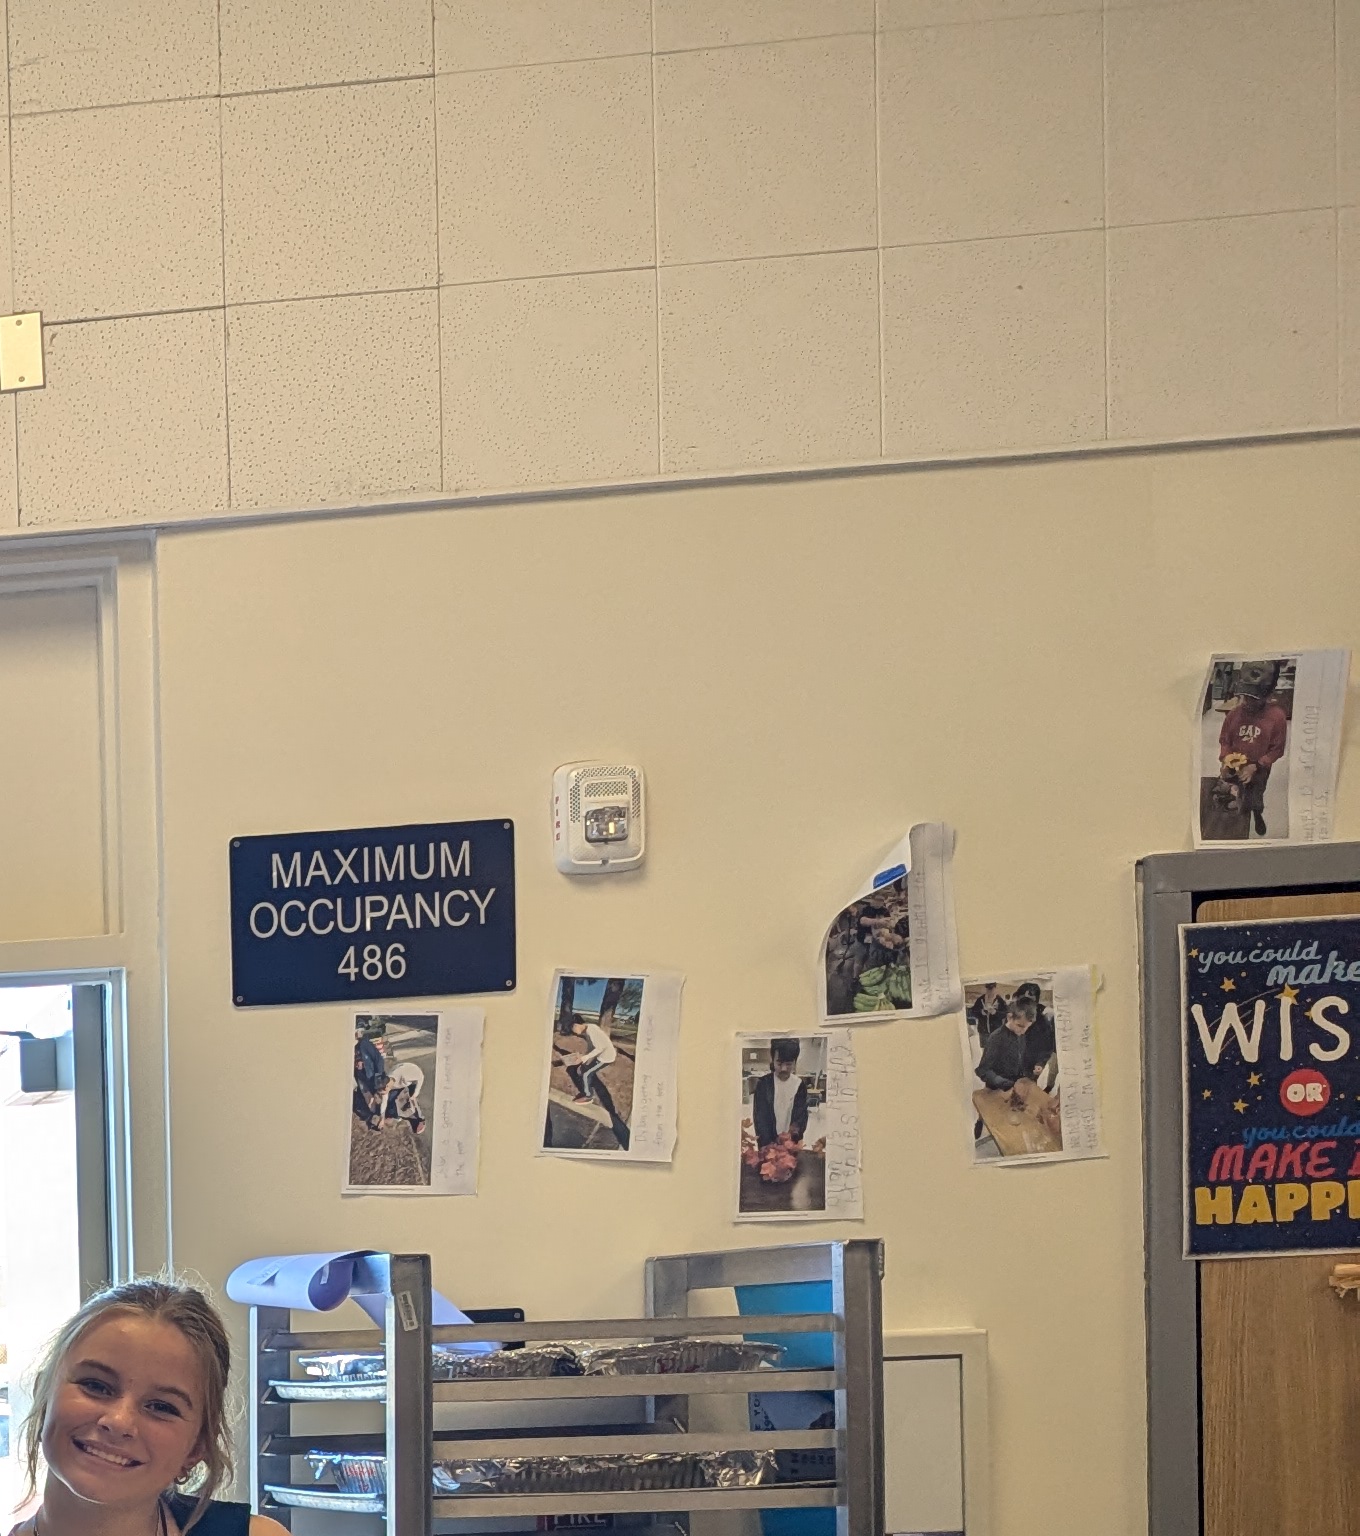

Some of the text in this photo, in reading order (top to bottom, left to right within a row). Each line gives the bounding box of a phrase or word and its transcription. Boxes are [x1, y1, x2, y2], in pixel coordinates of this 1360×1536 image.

[1238, 725, 1261, 739] GAP
[271, 840, 471, 889] MAXIMUM
[249, 888, 496, 939] OCCUPANCY
[337, 943, 407, 981] 486
[1197, 940, 1323, 974] you could
[1266, 950, 1360, 986] make
[1286, 1083, 1324, 1103] OR
[1243, 1126, 1288, 1149] you
[1208, 1141, 1338, 1182] MAKE
